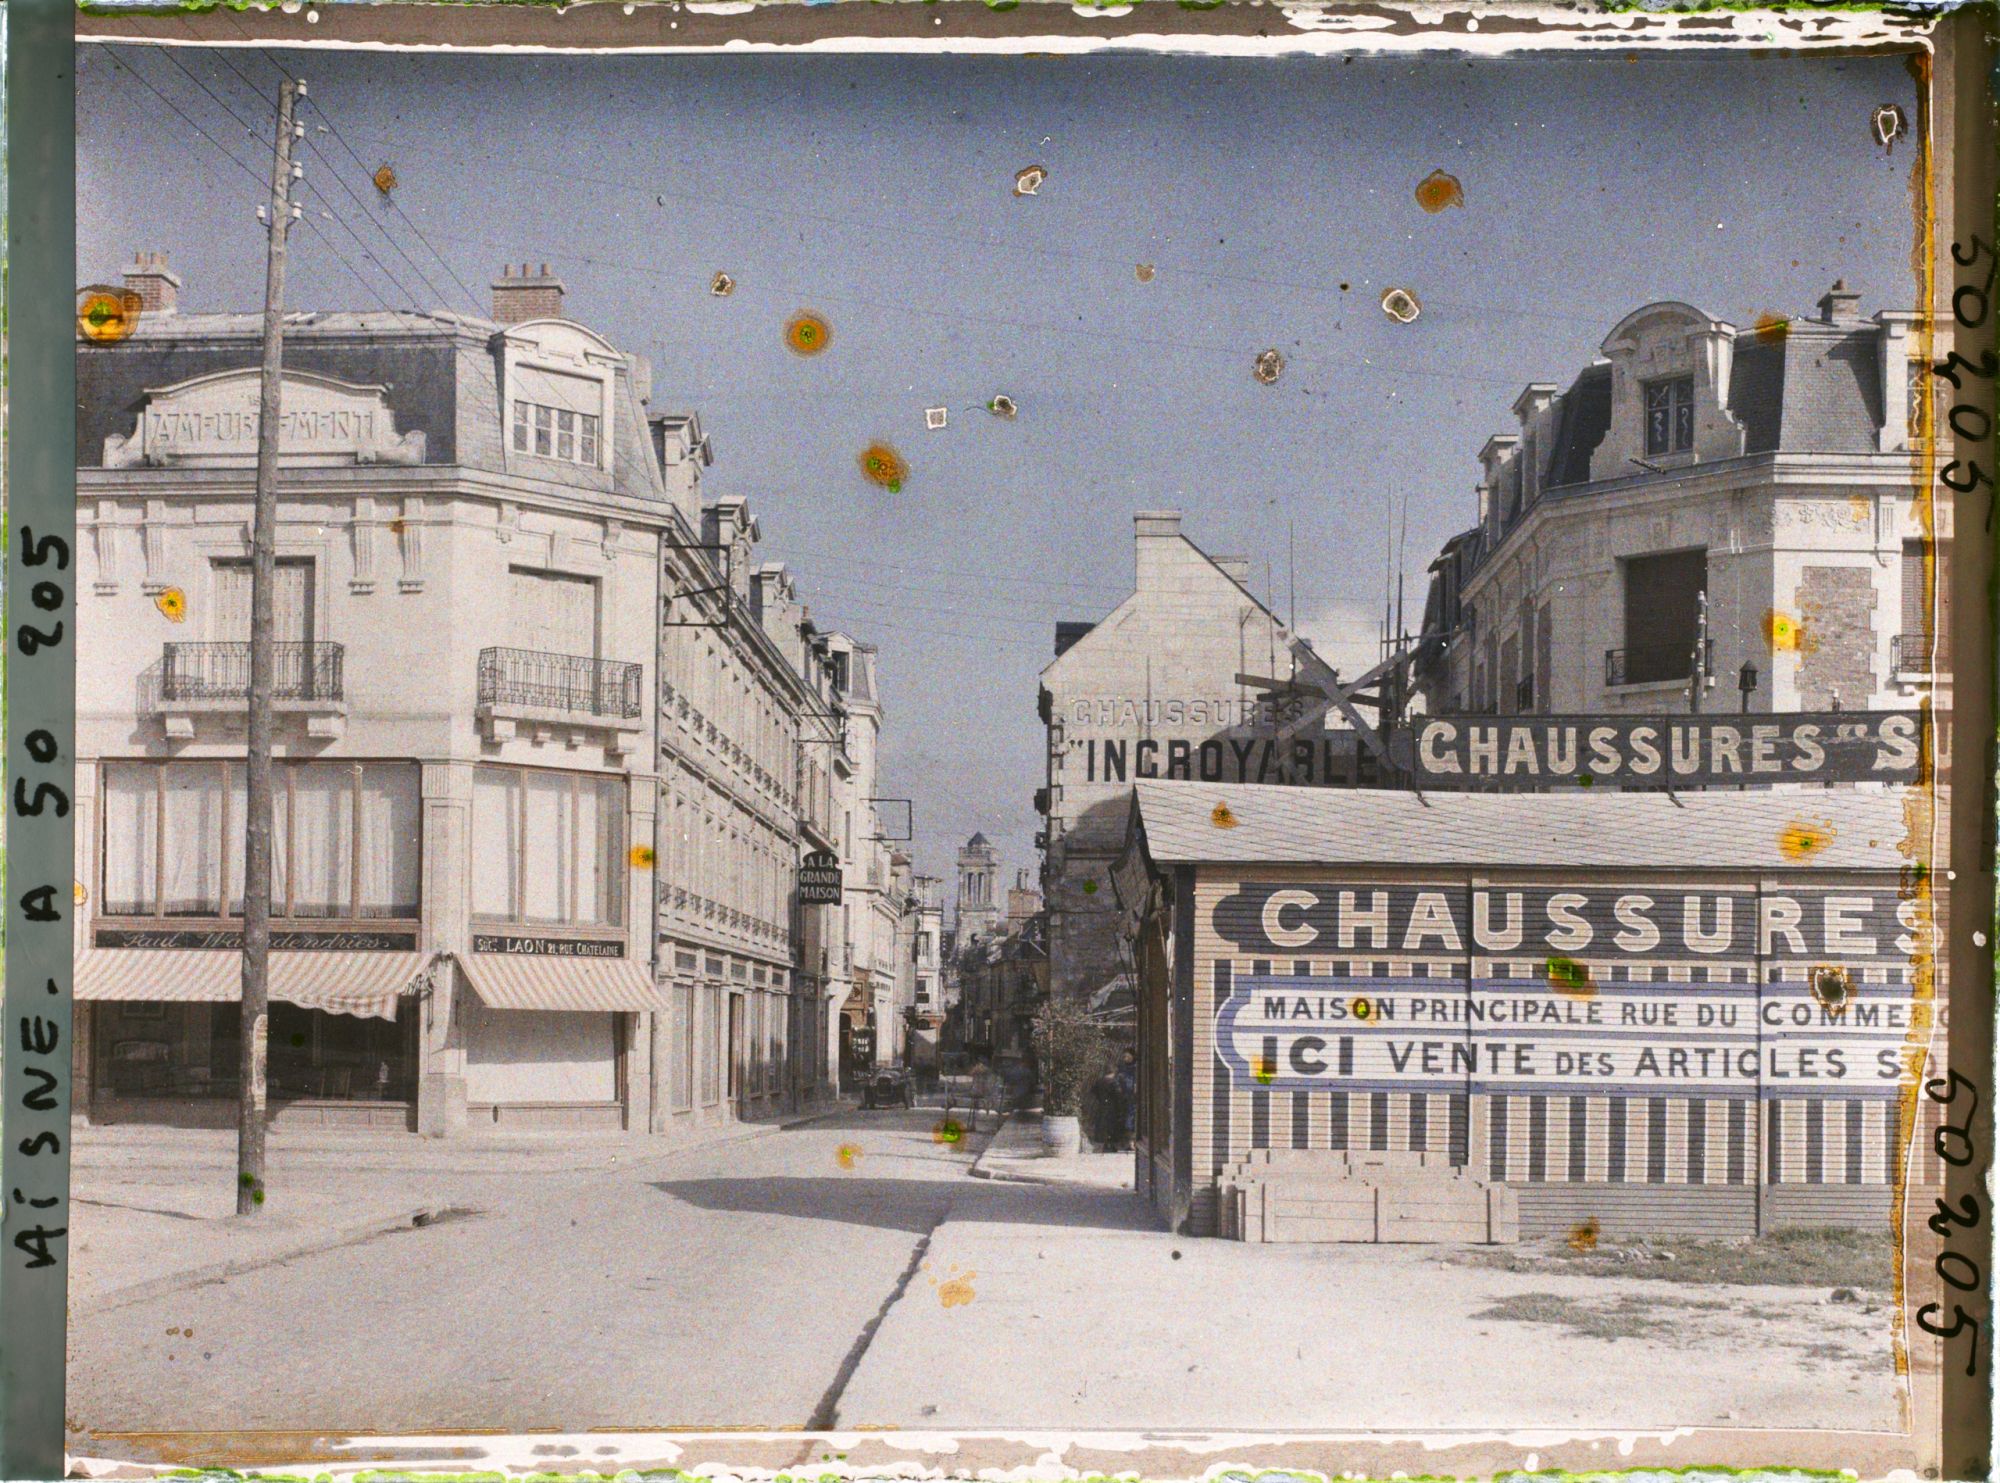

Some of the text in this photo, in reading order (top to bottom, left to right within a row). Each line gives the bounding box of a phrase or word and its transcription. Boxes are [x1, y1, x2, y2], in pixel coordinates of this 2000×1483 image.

[153, 411, 374, 442] AMEUBEMENT
[17, 525, 70, 656] 205
[1419, 720, 1827, 777] CHAUSSURES
[14, 729, 70, 818] 50
[799, 870, 841, 885] GRANDE
[807, 855, 834, 869] A LA
[20, 885, 62, 922] A
[799, 886, 840, 899] MAISON
[1261, 889, 1943, 955] CHAUSSURES
[122, 931, 184, 948] Paul
[506, 938, 545, 953] LAON
[1264, 996, 1394, 1020] MAISON
[1411, 998, 1603, 1026] PRINCIPALE
[1621, 1003, 1677, 1027] RUE
[1698, 1004, 1737, 1027] DU
[1262, 1035, 1354, 1076] ICI
[1387, 1041, 1536, 1076] VENTE
[1556, 1052, 1615, 1076] DES
[1635, 1046, 1848, 1079] ARTICLES
[1916, 1067, 1981, 1377] 50205
